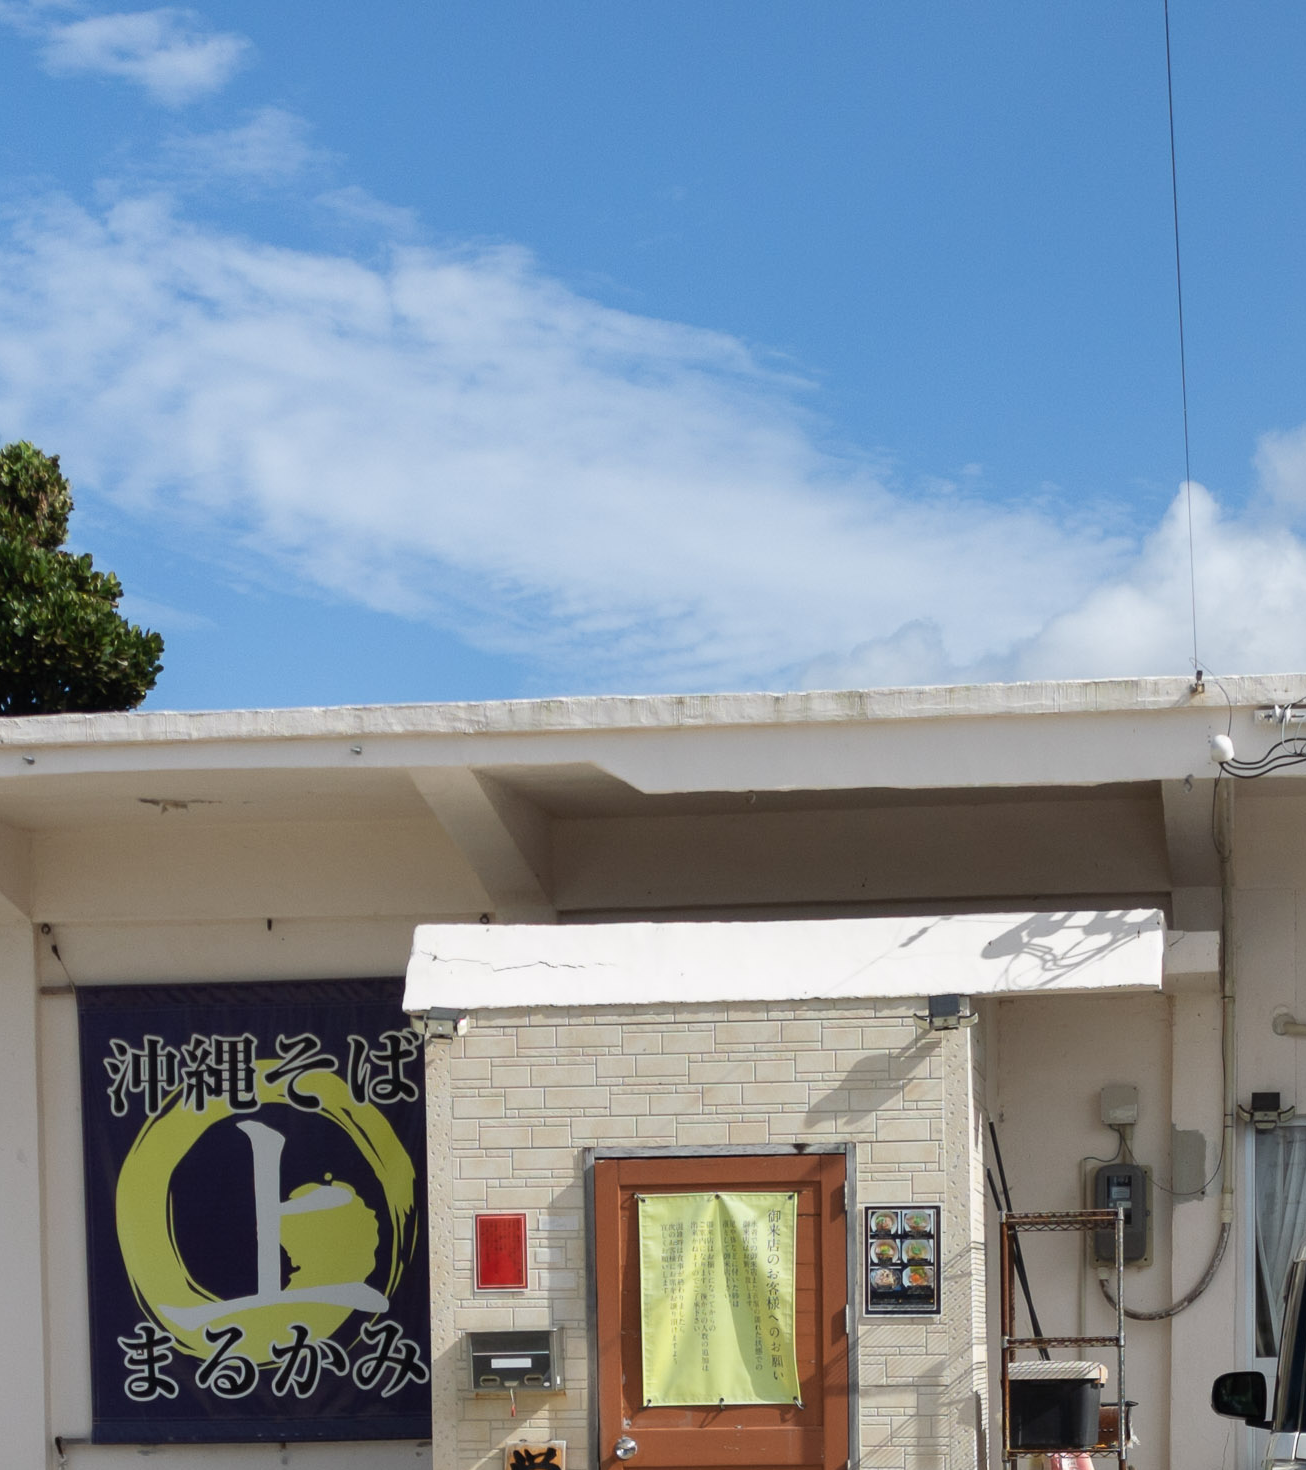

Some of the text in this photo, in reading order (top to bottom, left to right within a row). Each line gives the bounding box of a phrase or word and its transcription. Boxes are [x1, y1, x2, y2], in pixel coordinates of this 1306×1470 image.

[104, 1029, 422, 1117] 沖縄そば
[766, 1208, 784, 1380] 御来店のお客様へのお願い
[117, 1320, 430, 1402] まるかみ
